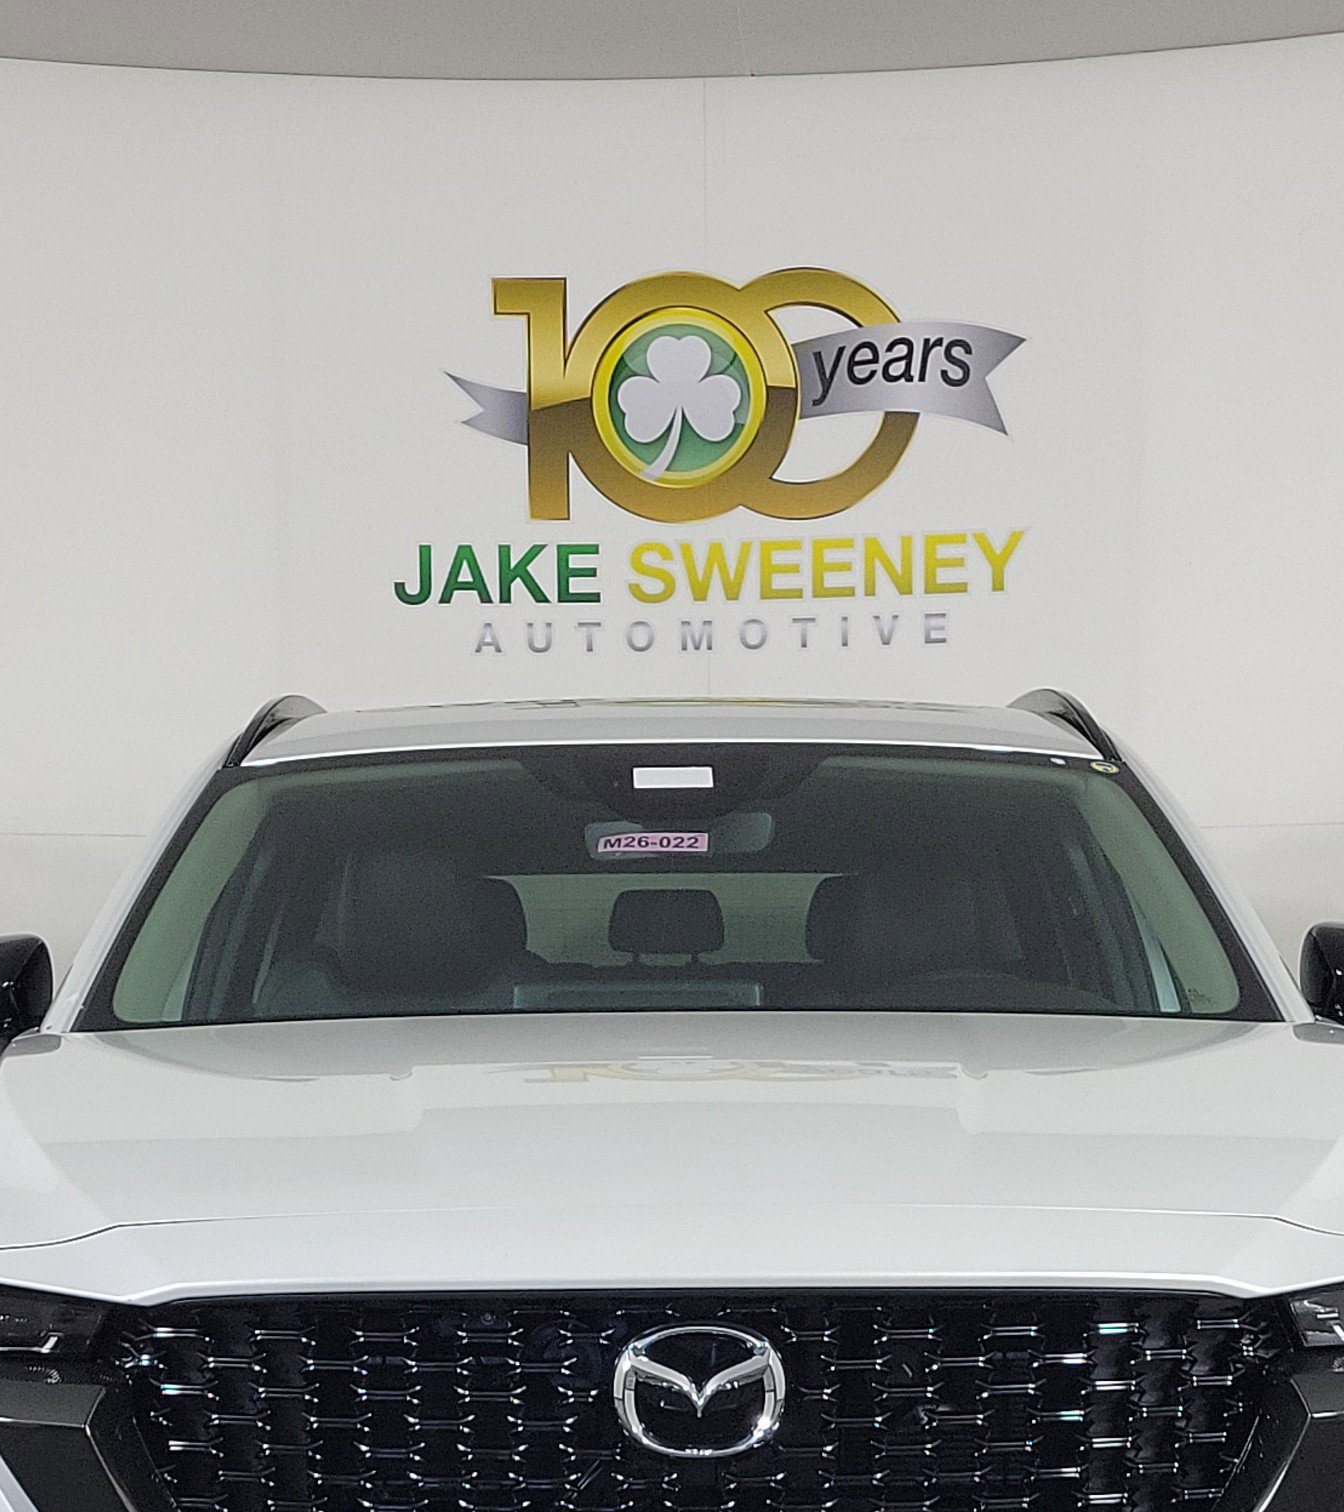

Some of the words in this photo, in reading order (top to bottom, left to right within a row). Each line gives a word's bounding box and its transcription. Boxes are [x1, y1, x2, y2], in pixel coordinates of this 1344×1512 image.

[492, 266, 920, 523] 100
[811, 334, 974, 406] years
[393, 543, 601, 606] JAKE
[627, 530, 1025, 604] SWEENEY
[474, 612, 949, 654] AUTOMOTIVE
[603, 836, 700, 849] M26-022
